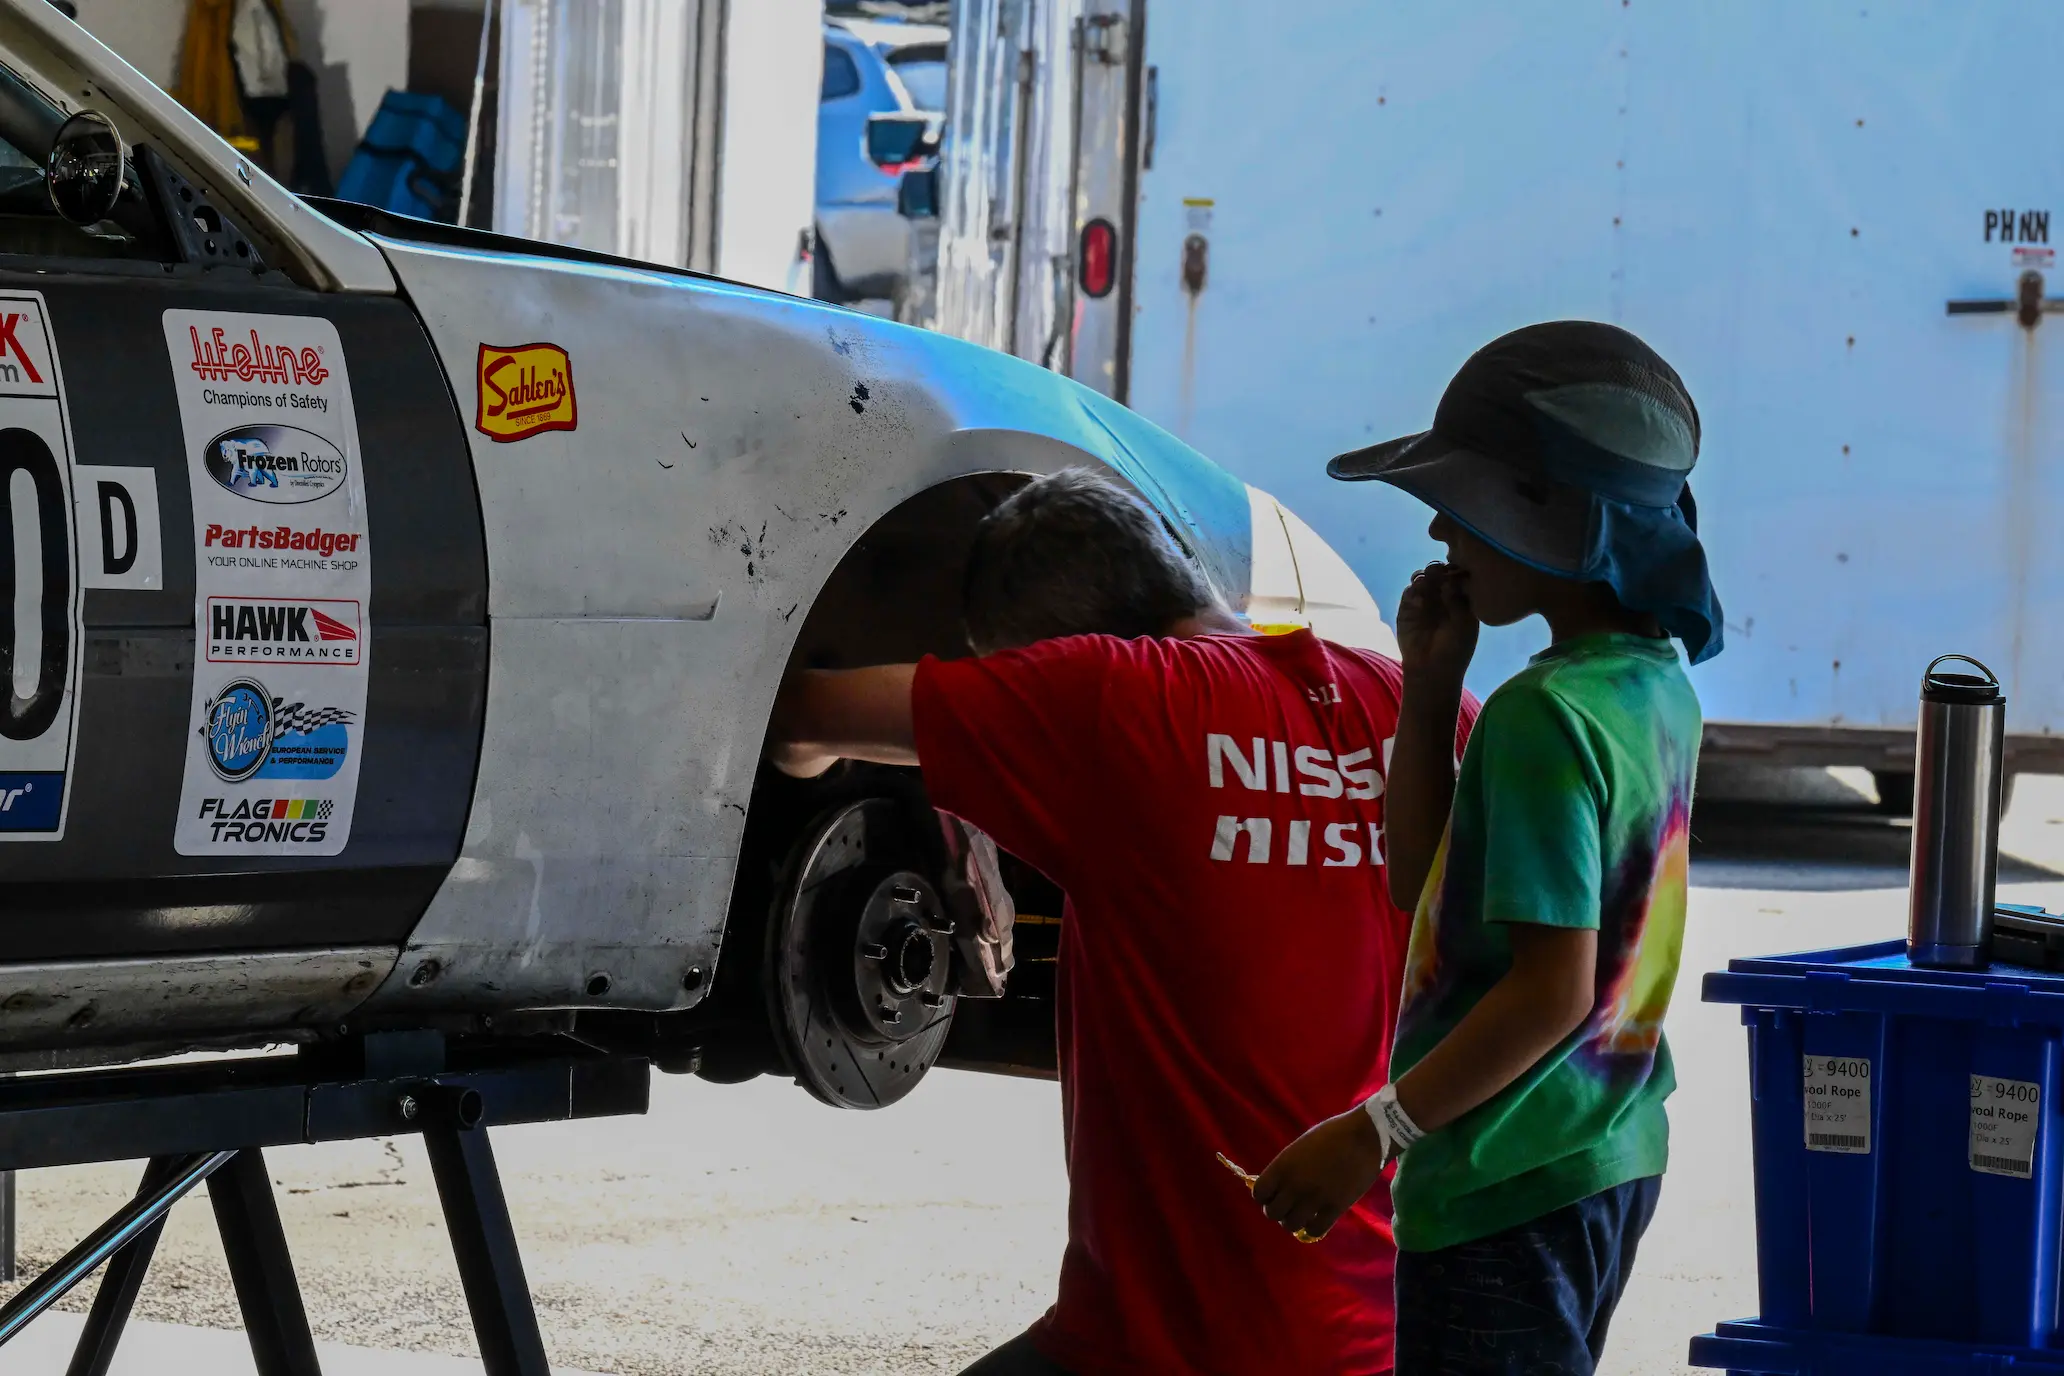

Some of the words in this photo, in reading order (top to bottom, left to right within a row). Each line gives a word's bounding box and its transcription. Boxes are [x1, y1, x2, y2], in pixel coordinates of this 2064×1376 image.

[484, 355, 566, 419] Sahlen's
[203, 389, 272, 408] Champions
[275, 393, 288, 407] of
[290, 393, 328, 412] Safety
[515, 415, 535, 427] SINCE
[236, 449, 299, 471] Frozen
[301, 451, 341, 473] Rotors
[97, 481, 138, 575] D
[205, 524, 359, 557] PartsBadger
[208, 556, 237, 567] YOUR
[239, 557, 278, 569] ONLINE
[281, 558, 328, 570] MACHINE
[331, 560, 358, 571] SHOP
[0, 427, 69, 741] 0
[212, 605, 310, 642] HAWK
[212, 645, 354, 658] PERFORMANCE
[215, 720, 274, 762] Wrench
[271, 747, 312, 755] EUROPEAN
[314, 747, 346, 755] SERVICE
[278, 757, 334, 765] PERFORMANCE
[198, 798, 273, 820] FLAG
[210, 821, 329, 843] TRONICS
[1827, 1060, 1869, 1078] 9400
[1831, 1085, 1861, 1100] Rope
[1995, 1082, 2038, 1103] 9400
[1998, 1107, 2028, 1123] Rope
